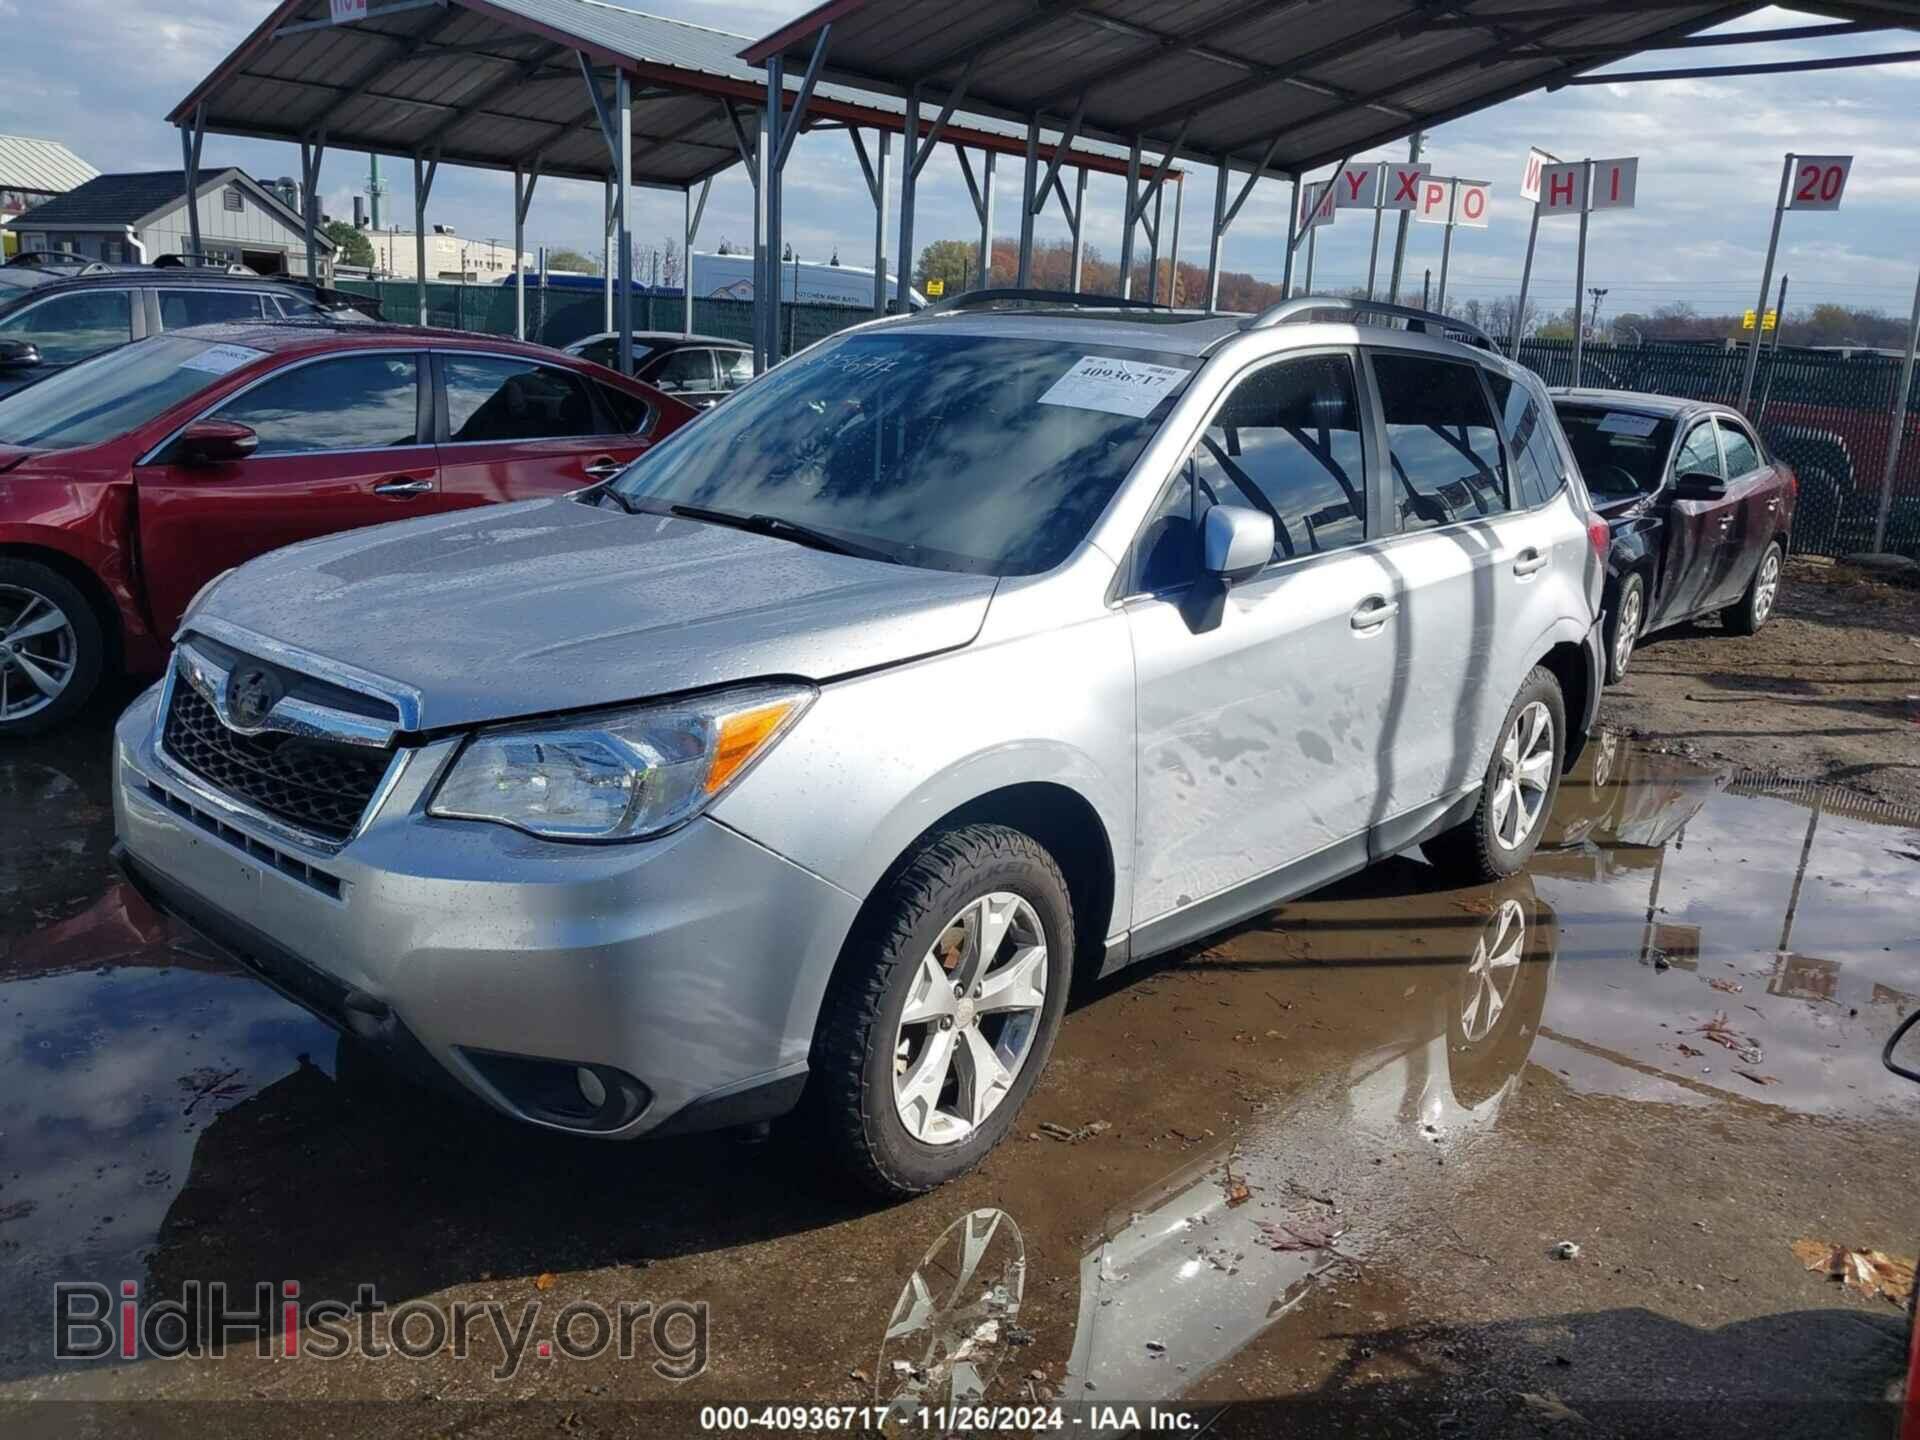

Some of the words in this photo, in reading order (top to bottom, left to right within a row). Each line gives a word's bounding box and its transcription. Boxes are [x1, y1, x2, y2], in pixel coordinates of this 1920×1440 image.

[1345, 171, 1367, 200] Y
[1395, 171, 1421, 201] X
[1550, 172, 1574, 206] H
[1611, 167, 1619, 201] I
[1797, 165, 1843, 201] 20
[1424, 184, 1444, 214] P
[1464, 188, 1485, 219] O
